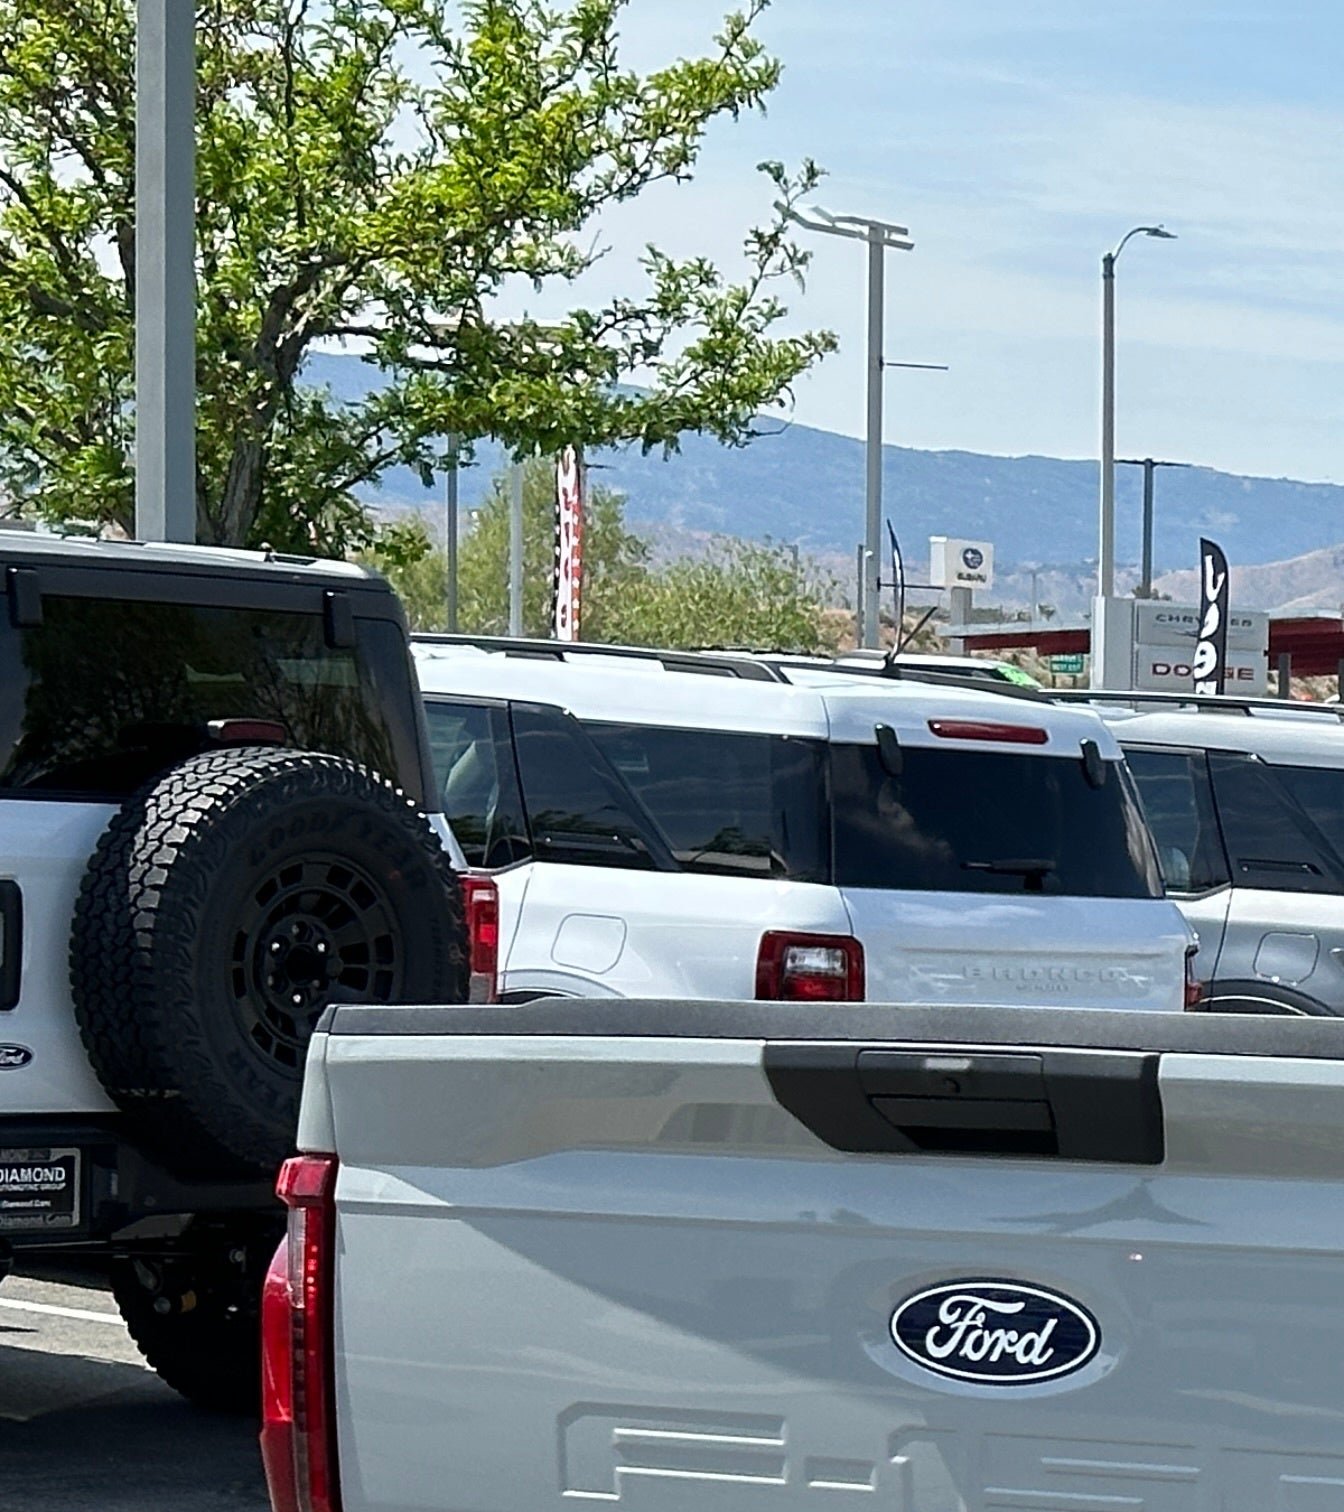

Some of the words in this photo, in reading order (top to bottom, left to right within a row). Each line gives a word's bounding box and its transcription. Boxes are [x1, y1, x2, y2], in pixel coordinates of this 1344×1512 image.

[1155, 612, 1253, 627] CHRYER
[1152, 662, 1254, 681] DOGE
[924, 1292, 1059, 1367] Ford
